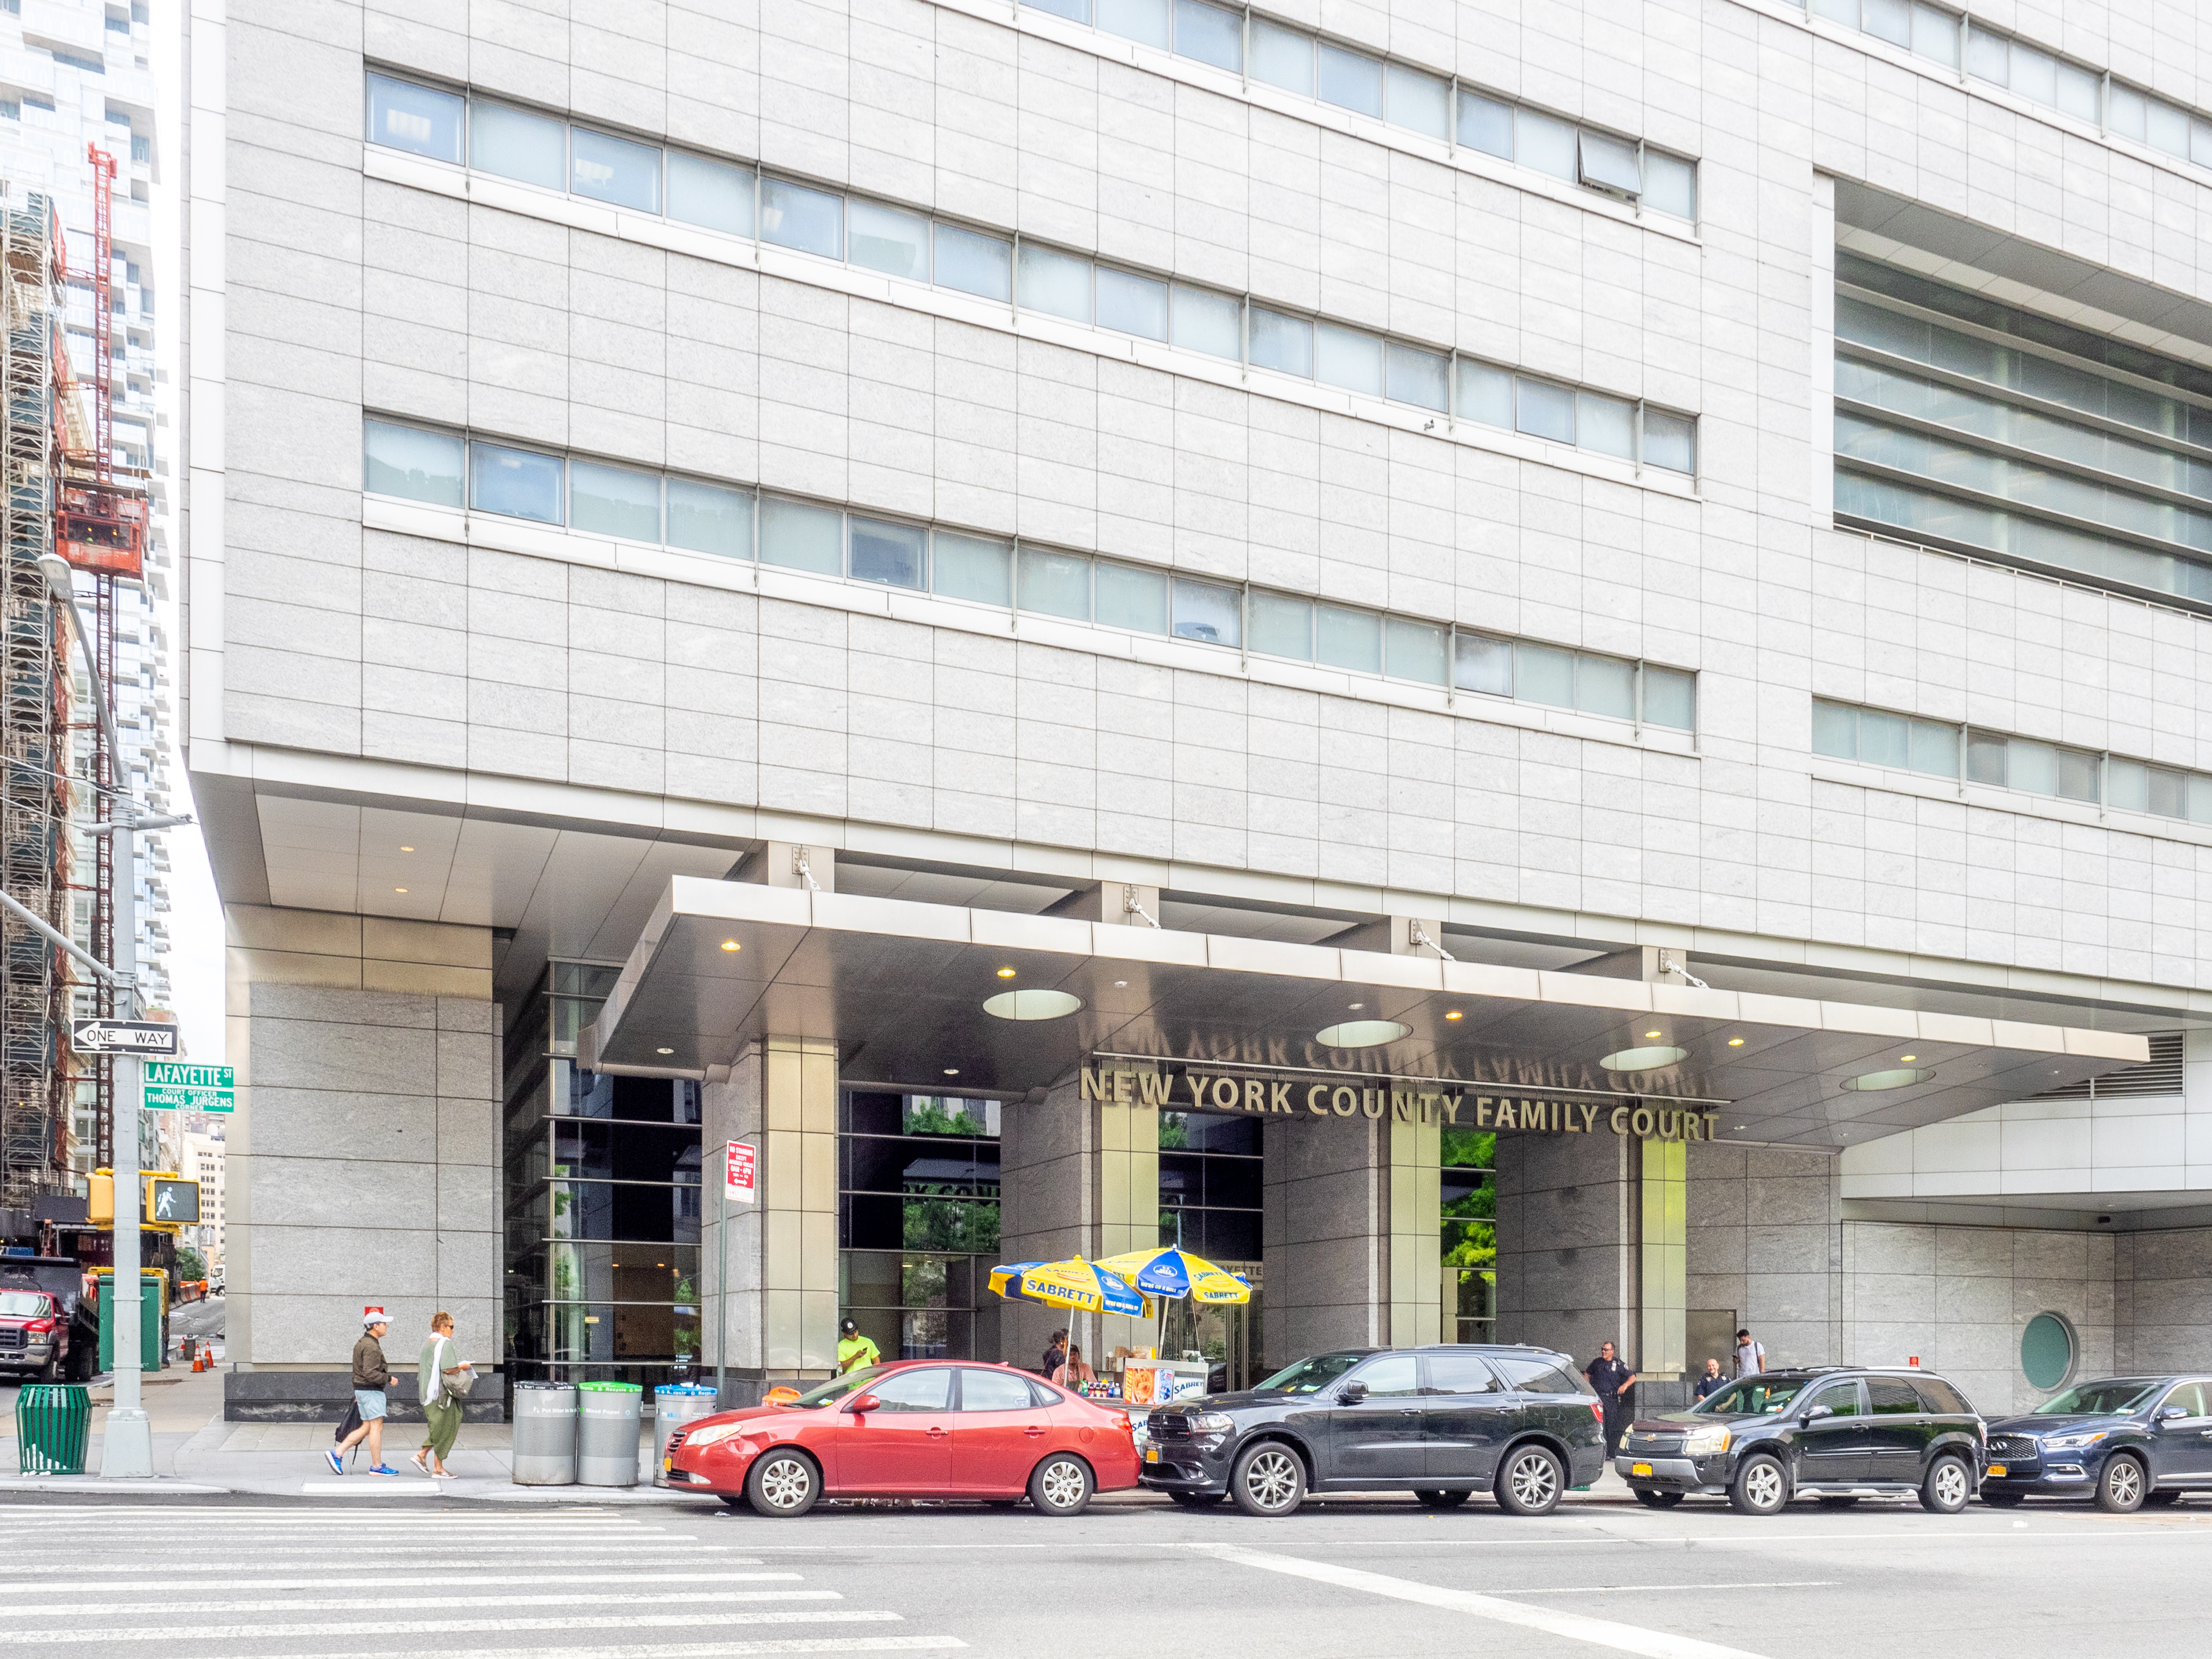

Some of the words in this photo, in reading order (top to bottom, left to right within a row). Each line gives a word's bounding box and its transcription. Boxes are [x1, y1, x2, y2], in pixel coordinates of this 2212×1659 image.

[87, 1030, 116, 1042] ONE
[135, 1032, 168, 1044] WAY
[145, 1063, 222, 1086] LAFAYETTE
[223, 1068, 232, 1078] ST
[146, 1093, 185, 1104] THOMAS
[190, 1096, 232, 1107] JURGENS
[1080, 1068, 1173, 1105] NEW
[1187, 1076, 1293, 1114] YORK
[1307, 1085, 1463, 1124] COUNTY
[1475, 1097, 1599, 1133] FAMILY
[1610, 1106, 1719, 1140] COURT
[736, 1147, 753, 1156] STANDING
[1193, 1271, 1223, 1281] SABRETT
[1026, 1280, 1096, 1304] SABRETT
[1125, 1370, 1133, 1402] PRETZEL
